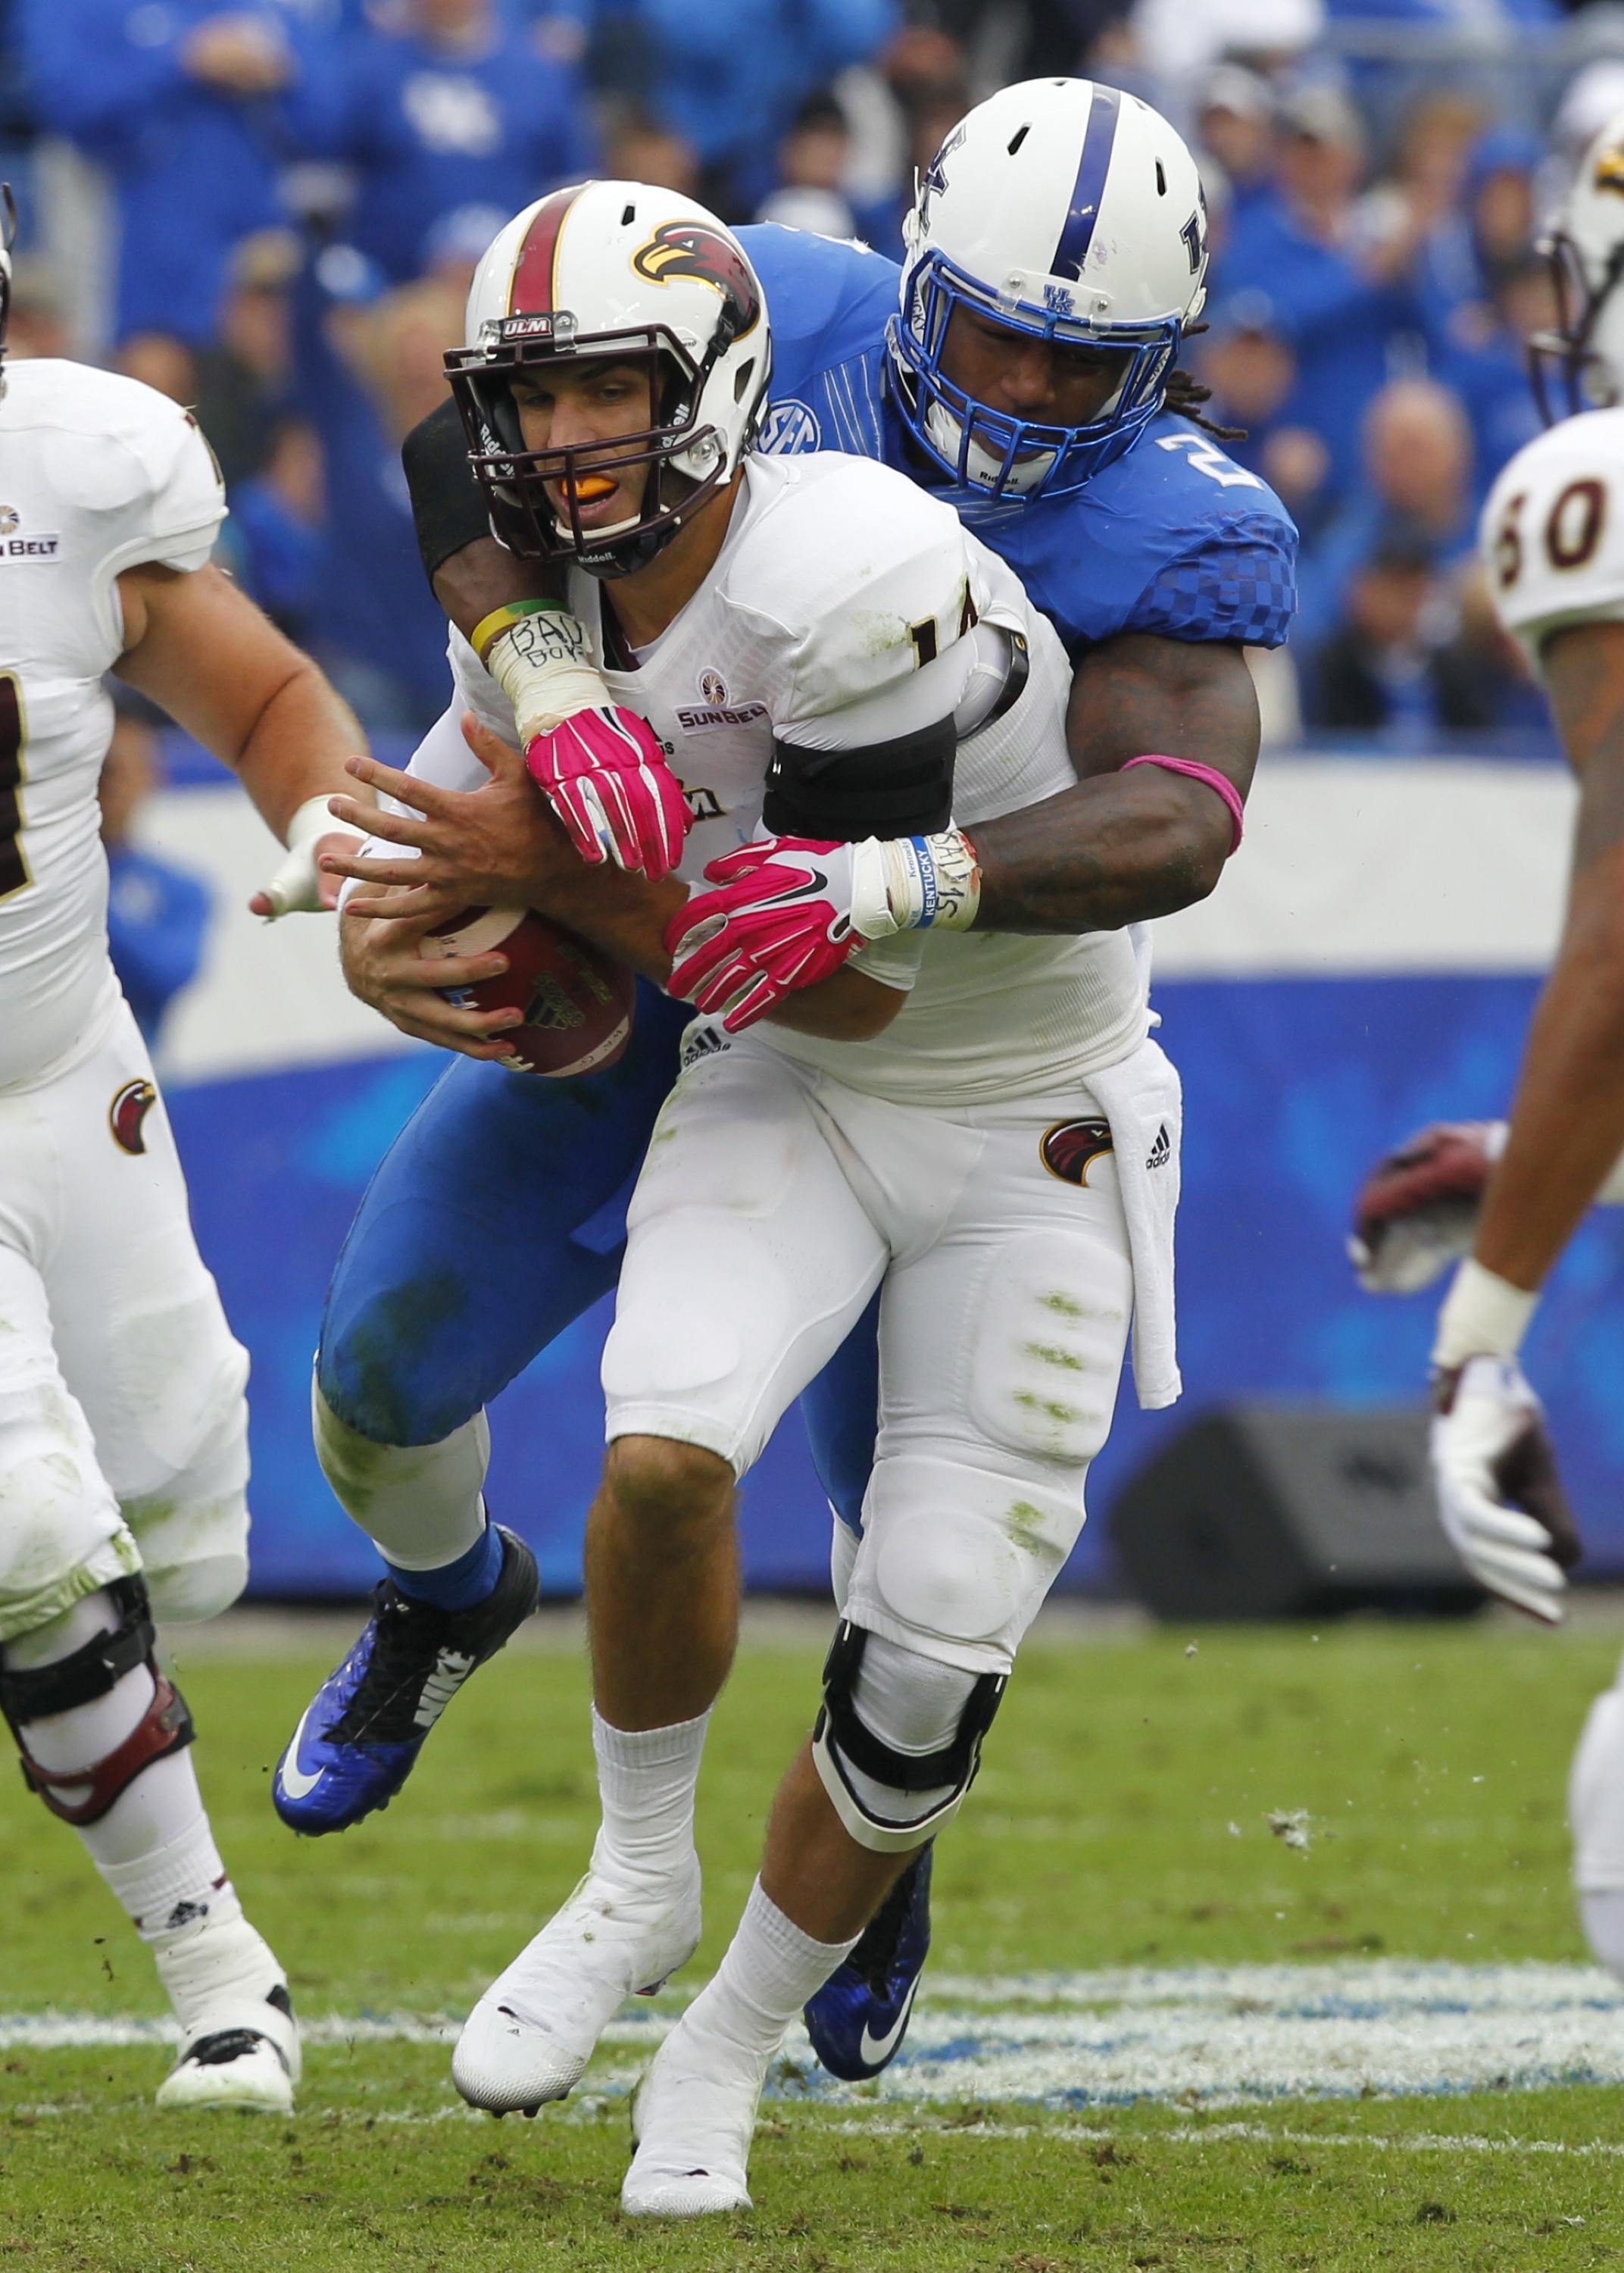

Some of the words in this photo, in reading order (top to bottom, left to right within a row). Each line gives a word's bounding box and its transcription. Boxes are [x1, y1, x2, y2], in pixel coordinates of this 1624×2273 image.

[503, 317, 552, 339] ULM
[979, 471, 1019, 485] Ridll
[1154, 433, 1265, 492] 2
[1496, 478, 1607, 589] 60
[917, 849, 936, 916] KENTUCKY
[413, 1646, 476, 1727] NIKE
